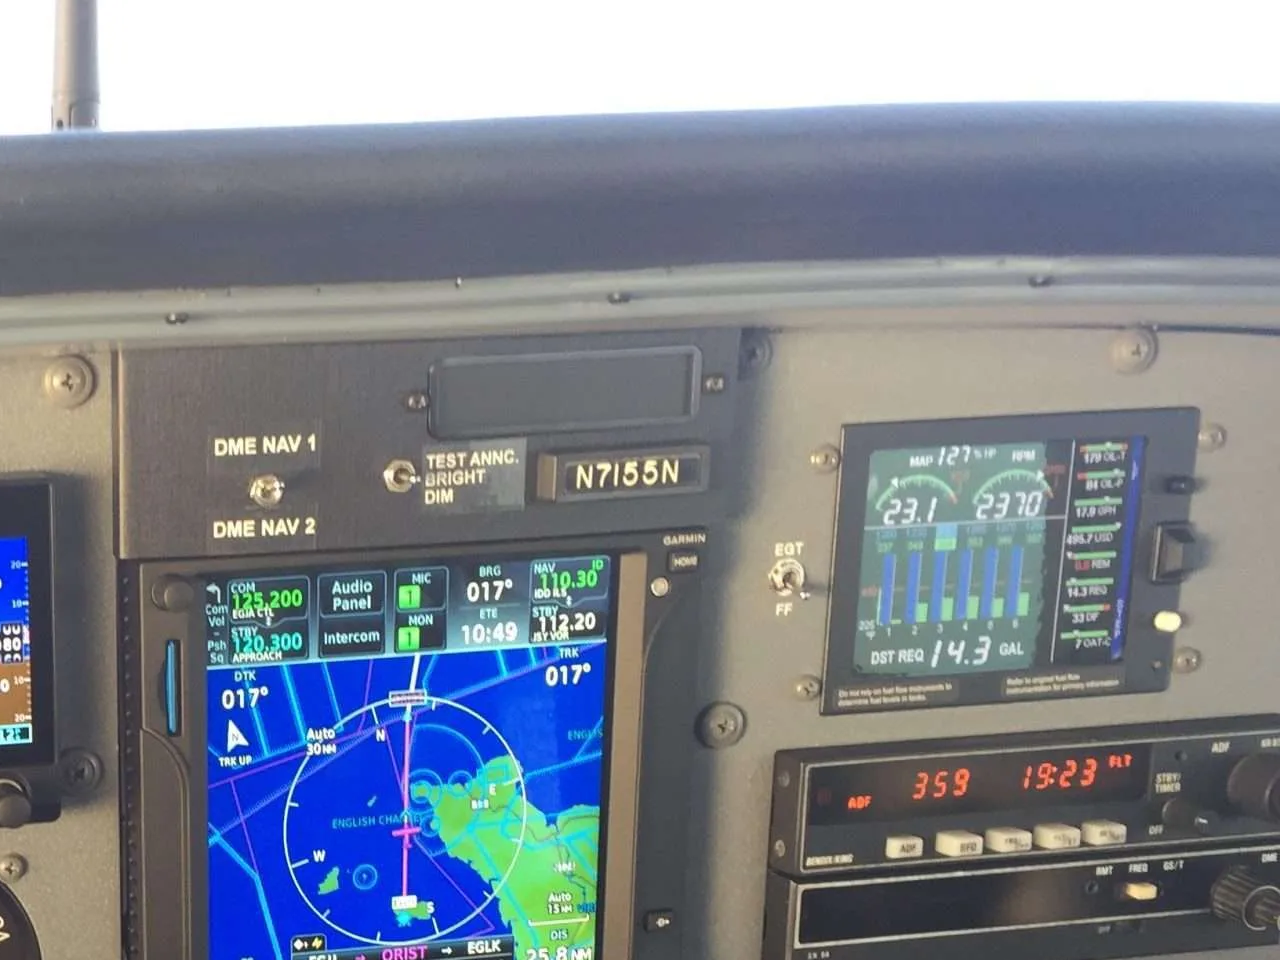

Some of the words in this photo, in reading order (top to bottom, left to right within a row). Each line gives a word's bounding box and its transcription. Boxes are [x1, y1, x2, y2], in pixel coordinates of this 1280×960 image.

[214, 438, 257, 456] DME
[261, 436, 300, 454] NAV
[308, 435, 316, 451] 1
[426, 453, 466, 469] TEST
[471, 449, 519, 467] ANNC.
[910, 455, 933, 468] MAP
[425, 469, 486, 487] BRIGHT
[575, 460, 679, 488] N7155N
[424, 489, 454, 505] DIM
[975, 492, 1042, 518] 2370
[883, 498, 937, 525] 23.1
[213, 521, 257, 539] DME
[261, 519, 301, 537] NAV
[304, 518, 315, 535] 2
[663, 534, 705, 546] GARMIN
[775, 542, 804, 557] EGT
[331, 580, 373, 595] Audio
[539, 569, 597, 589] 110.30
[232, 589, 302, 611] 125.200
[332, 596, 372, 611] Panel
[479, 608, 498, 619] ETE
[776, 603, 793, 617] FF
[408, 614, 433, 626] MON
[538, 613, 595, 632] 112.20
[232, 633, 303, 653] 120.300
[323, 629, 380, 646] Intercom
[461, 623, 518, 645] 10:49
[232, 650, 283, 663] APPROACH
[871, 651, 894, 664] DST
[899, 649, 924, 663] REQ
[932, 636, 990, 667] 14.3
[999, 643, 1023, 657] GAL
[1023, 758, 1096, 790] 19:23
[913, 768, 970, 800] 359
[332, 817, 374, 829] ENGLISH
[467, 940, 501, 955] EGLK
